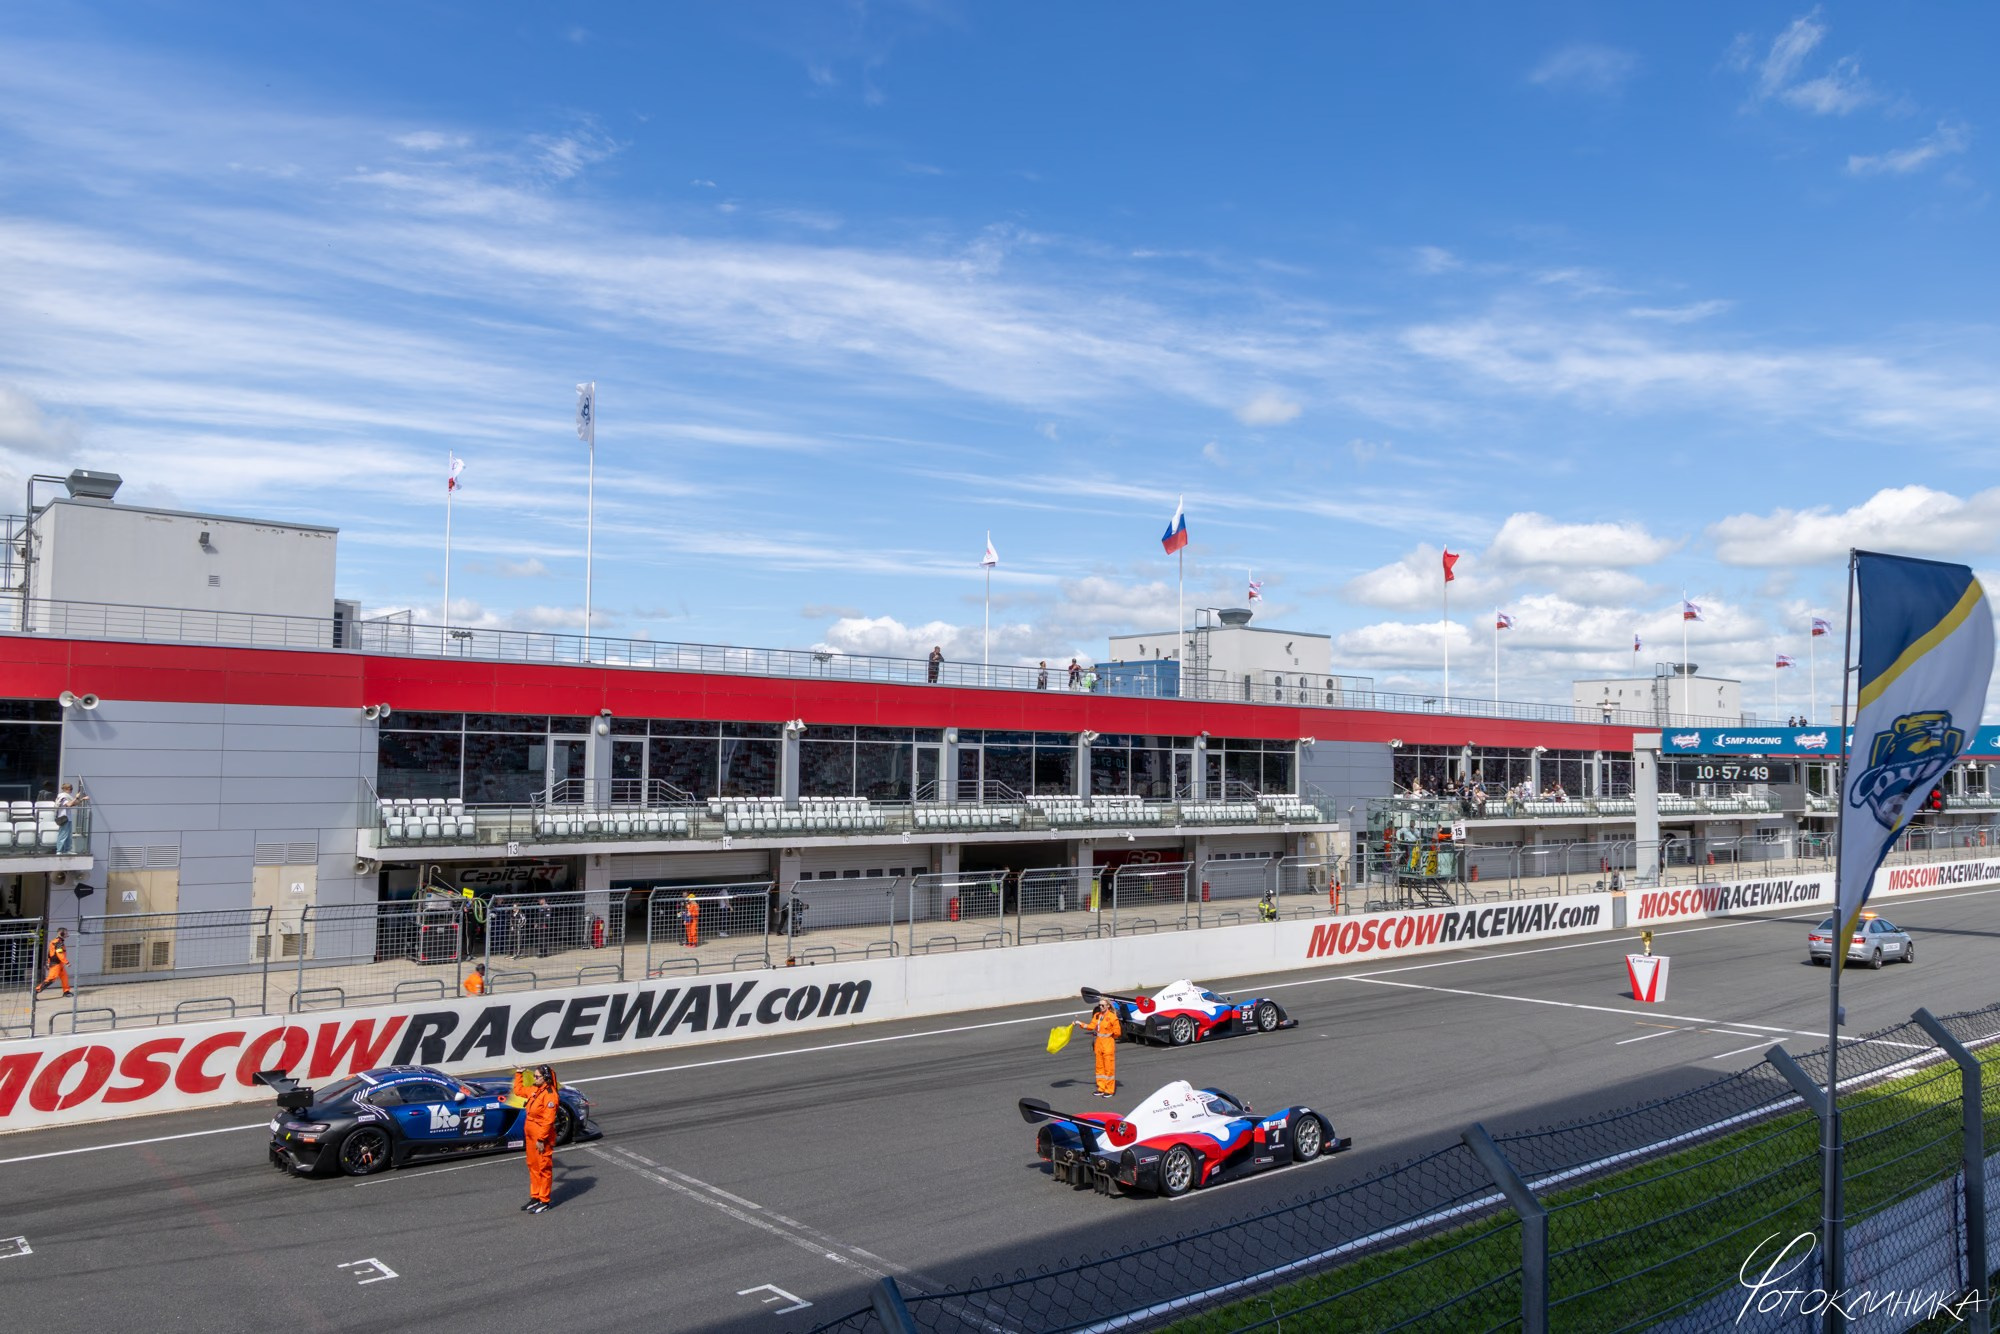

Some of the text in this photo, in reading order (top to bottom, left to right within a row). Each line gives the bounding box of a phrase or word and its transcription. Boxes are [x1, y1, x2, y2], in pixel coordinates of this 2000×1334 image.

[1725, 737, 1782, 745] SMP RACING
[1454, 827, 1463, 836] 15
[723, 838, 732, 848] 14
[903, 833, 910, 843] 15
[508, 844, 518, 855] 13
[1637, 880, 1821, 920] MOSCOWRACEWAY.com
[1306, 903, 1600, 958] MOSCOWRACEWAY.com
[1242, 1011, 1253, 1020] 51
[464, 1115, 485, 1130] 16
[1272, 1130, 1280, 1143] 1
